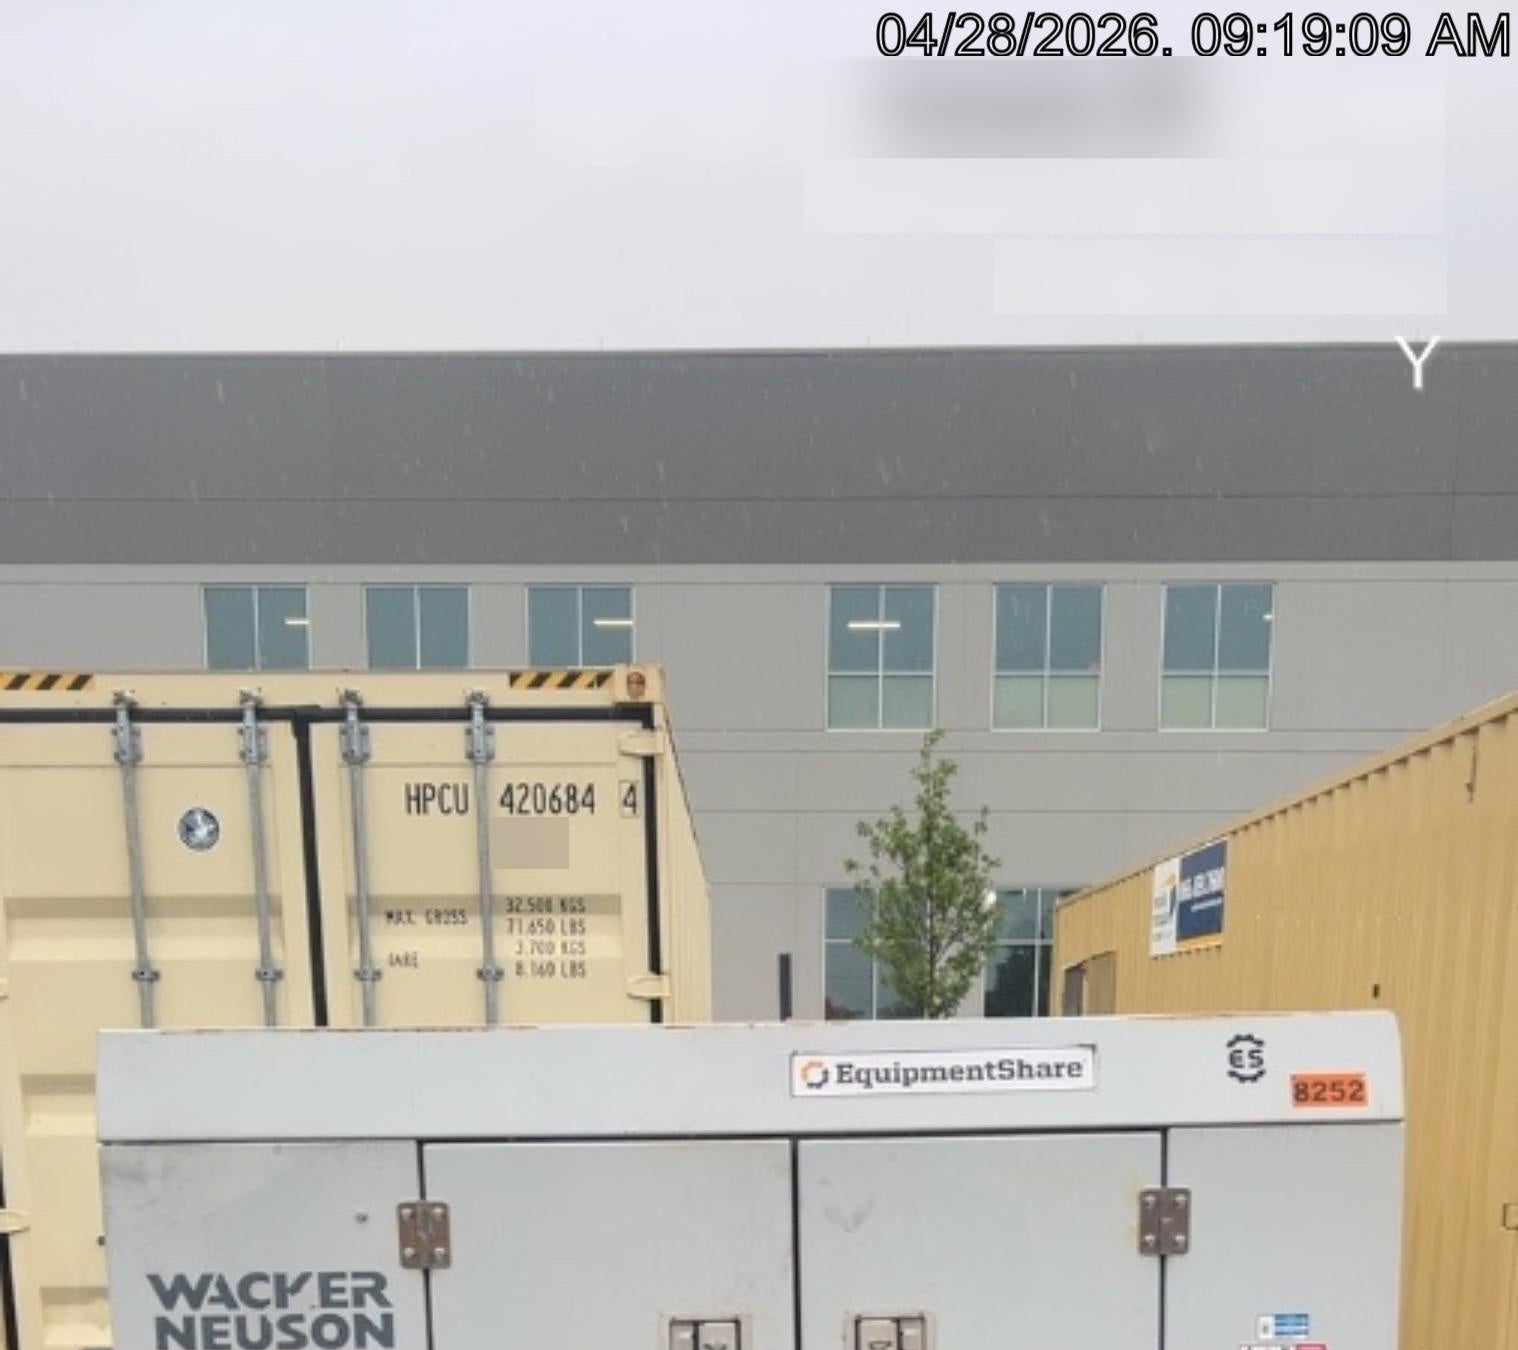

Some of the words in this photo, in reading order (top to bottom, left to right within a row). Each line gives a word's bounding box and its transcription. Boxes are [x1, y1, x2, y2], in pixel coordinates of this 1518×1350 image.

[405, 783, 468, 815] HPCU
[500, 782, 596, 814] 420684
[621, 783, 638, 815] 4
[560, 918, 586, 935] LBS
[560, 961, 586, 978] LBS
[836, 1058, 1083, 1089] EquipmentShare
[1293, 1080, 1364, 1102] 8252
[146, 1271, 393, 1311] WACKER
